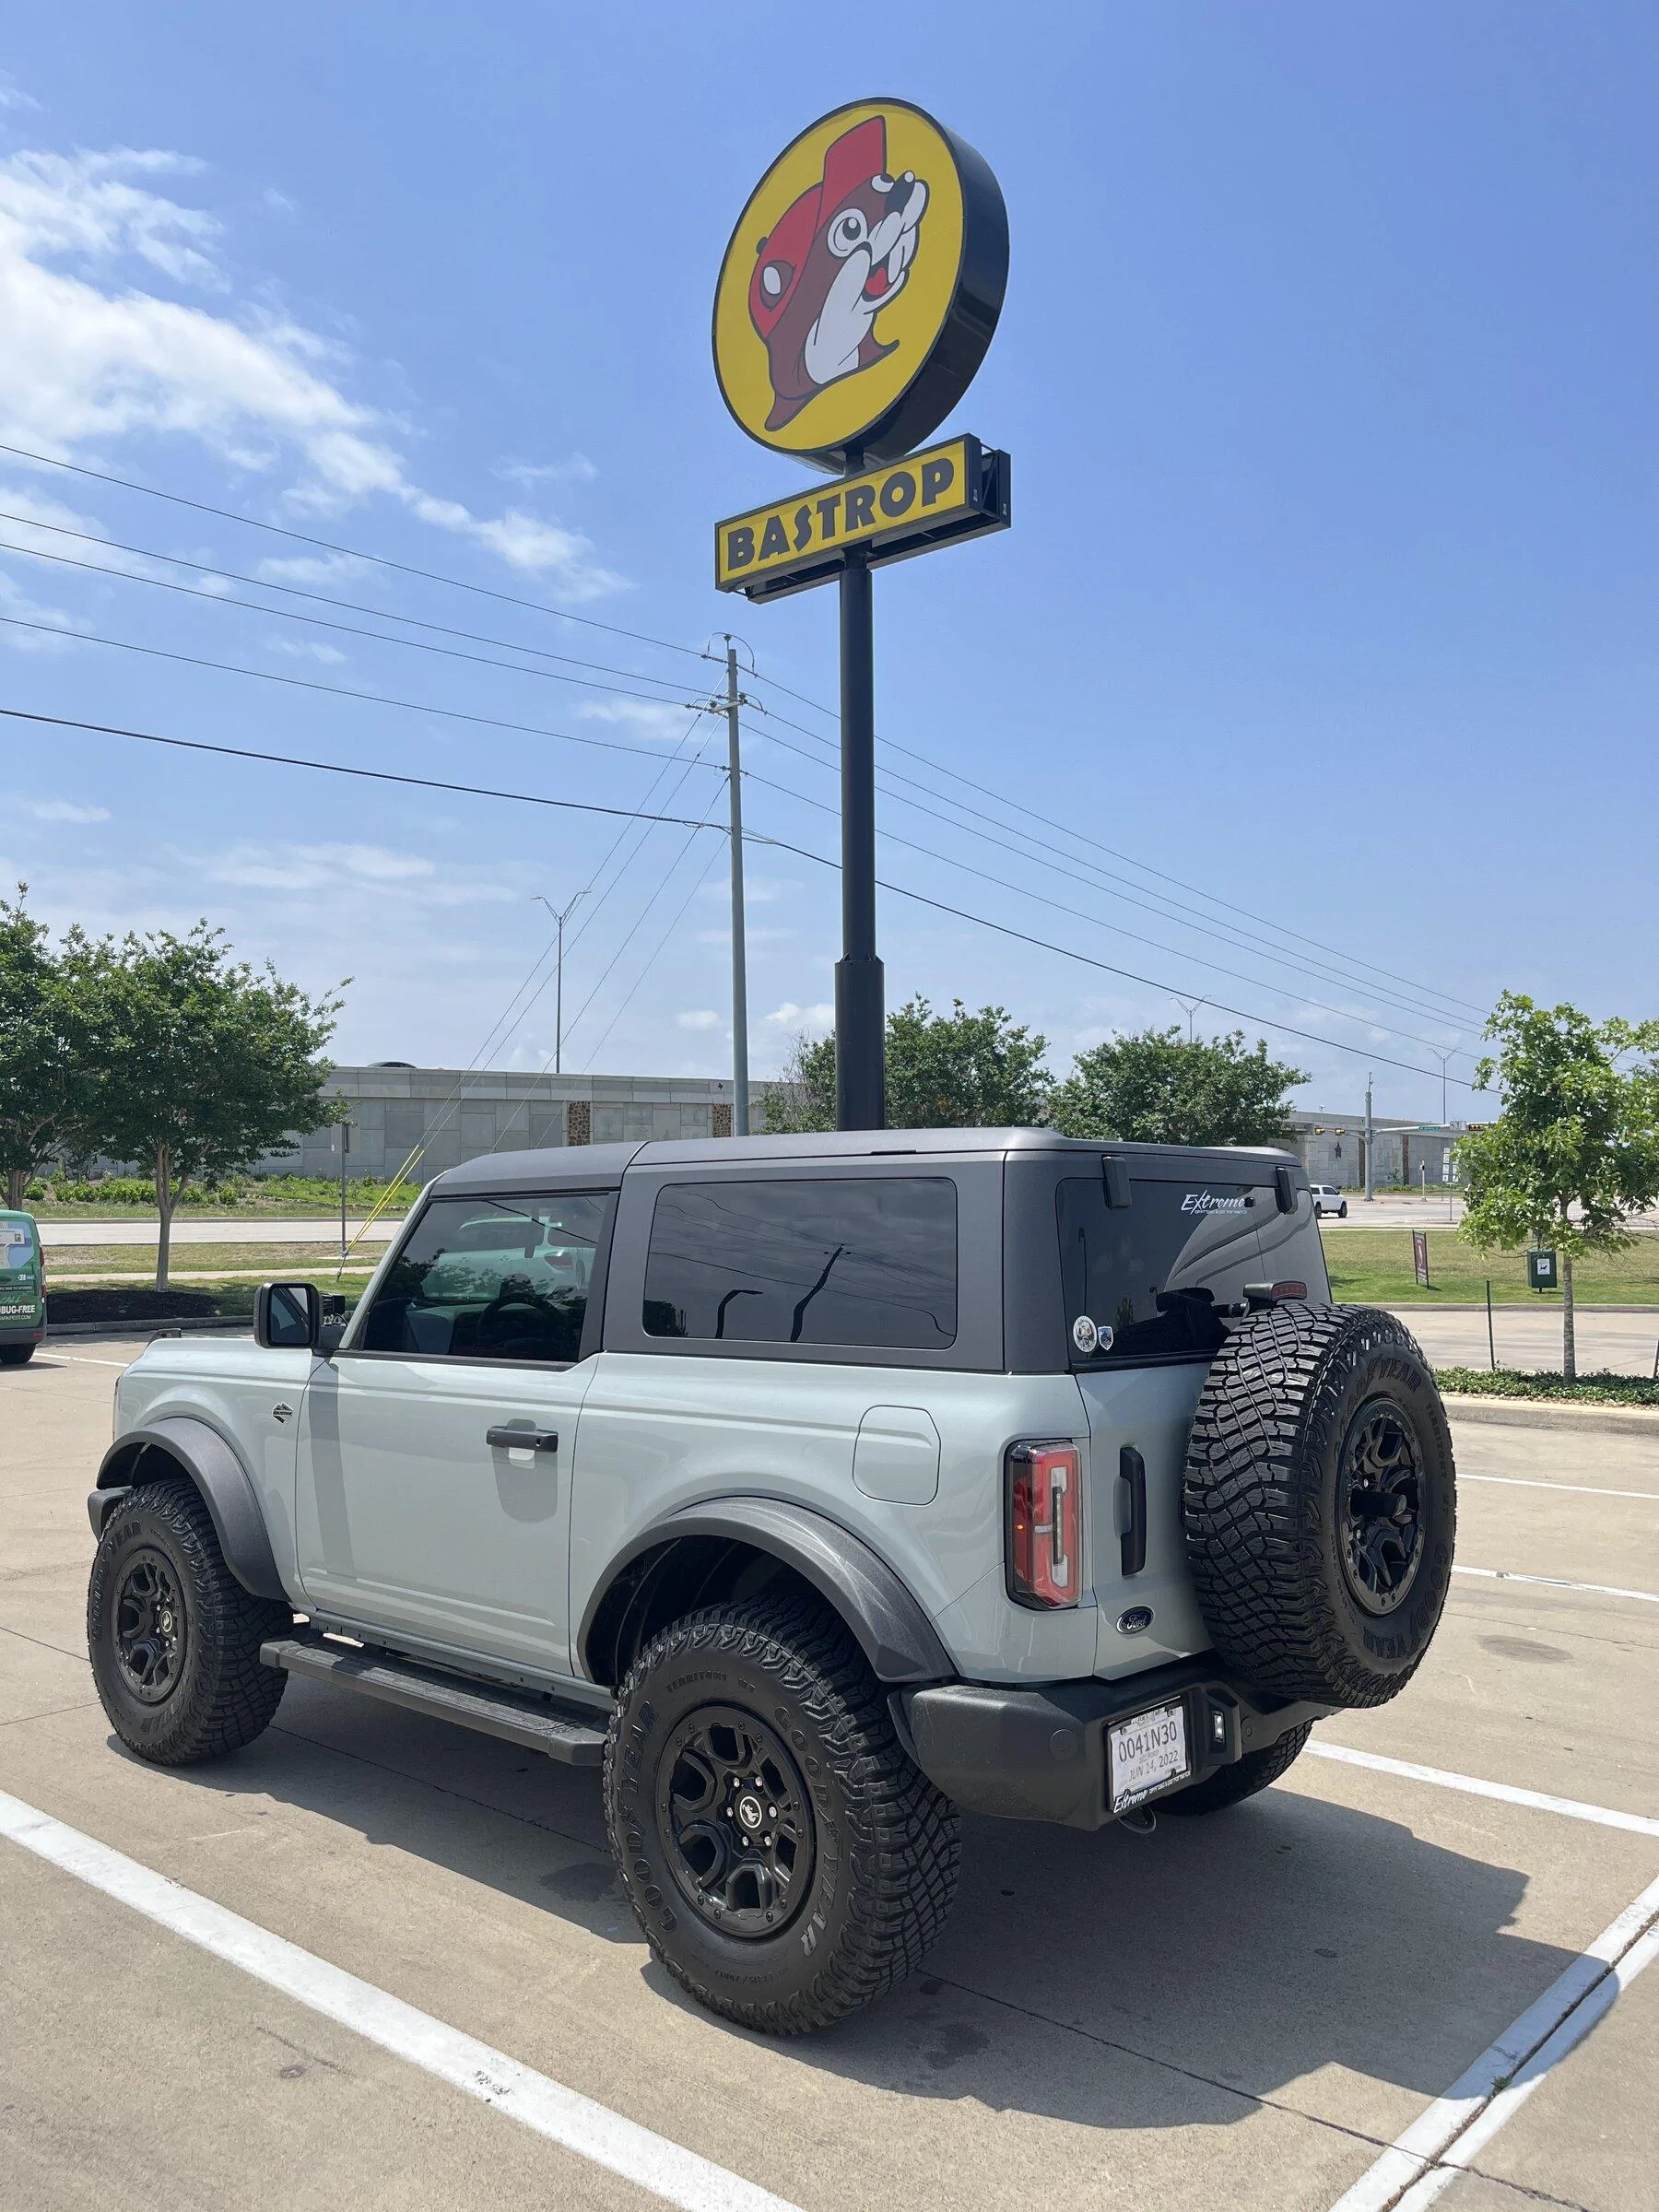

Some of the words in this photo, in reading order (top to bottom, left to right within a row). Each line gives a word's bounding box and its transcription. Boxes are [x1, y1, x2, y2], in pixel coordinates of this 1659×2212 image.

[726, 457, 955, 571] BASTROP
[1181, 1190, 1246, 1215] Extreme
[1159, 1749, 1179, 1768] 2022
[1113, 1788, 1148, 1814] Extreme
